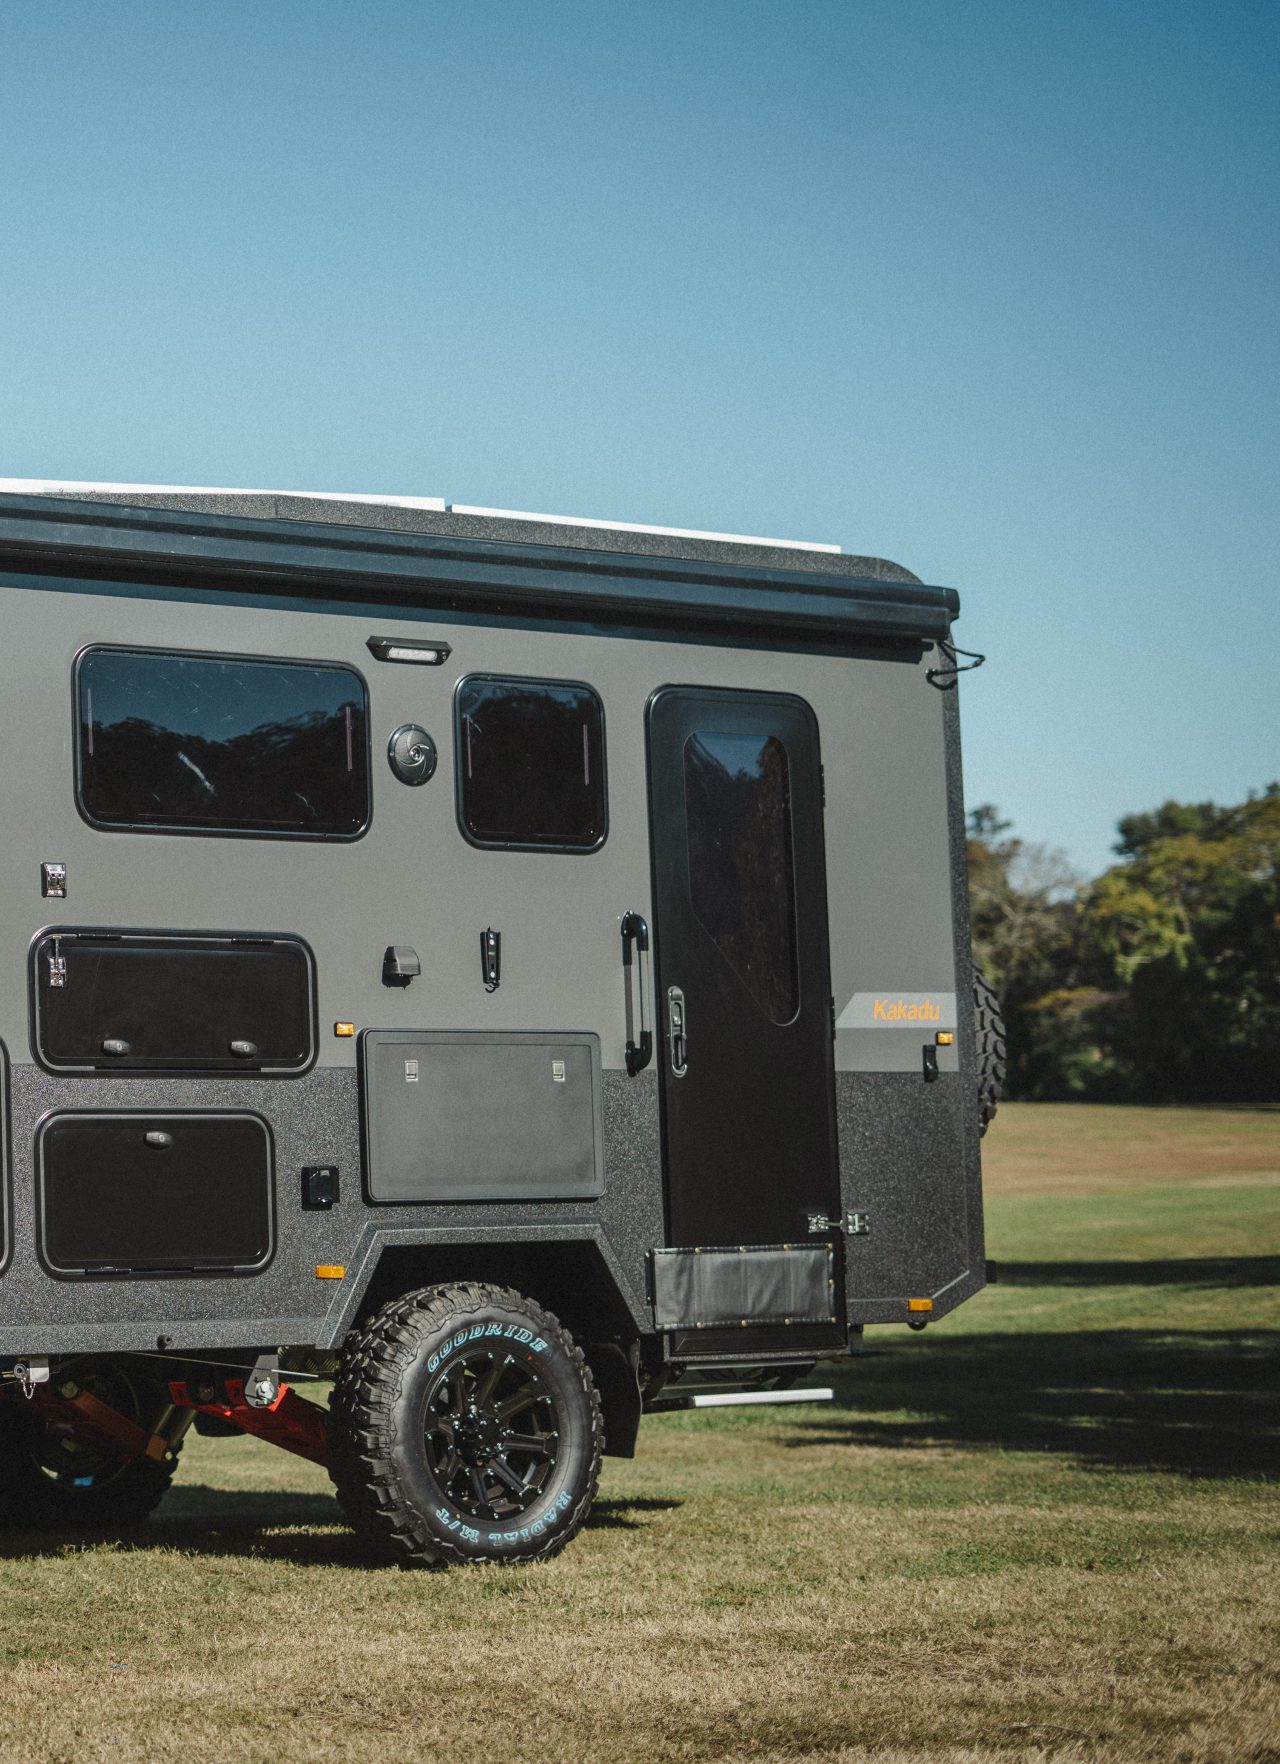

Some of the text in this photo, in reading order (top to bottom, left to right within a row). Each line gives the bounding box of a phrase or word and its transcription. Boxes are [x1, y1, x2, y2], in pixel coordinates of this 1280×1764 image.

[872, 999, 941, 1021] Kakadu
[427, 1321, 549, 1373] GOODRIDE
[435, 1491, 572, 1546] RADIAL M/T
